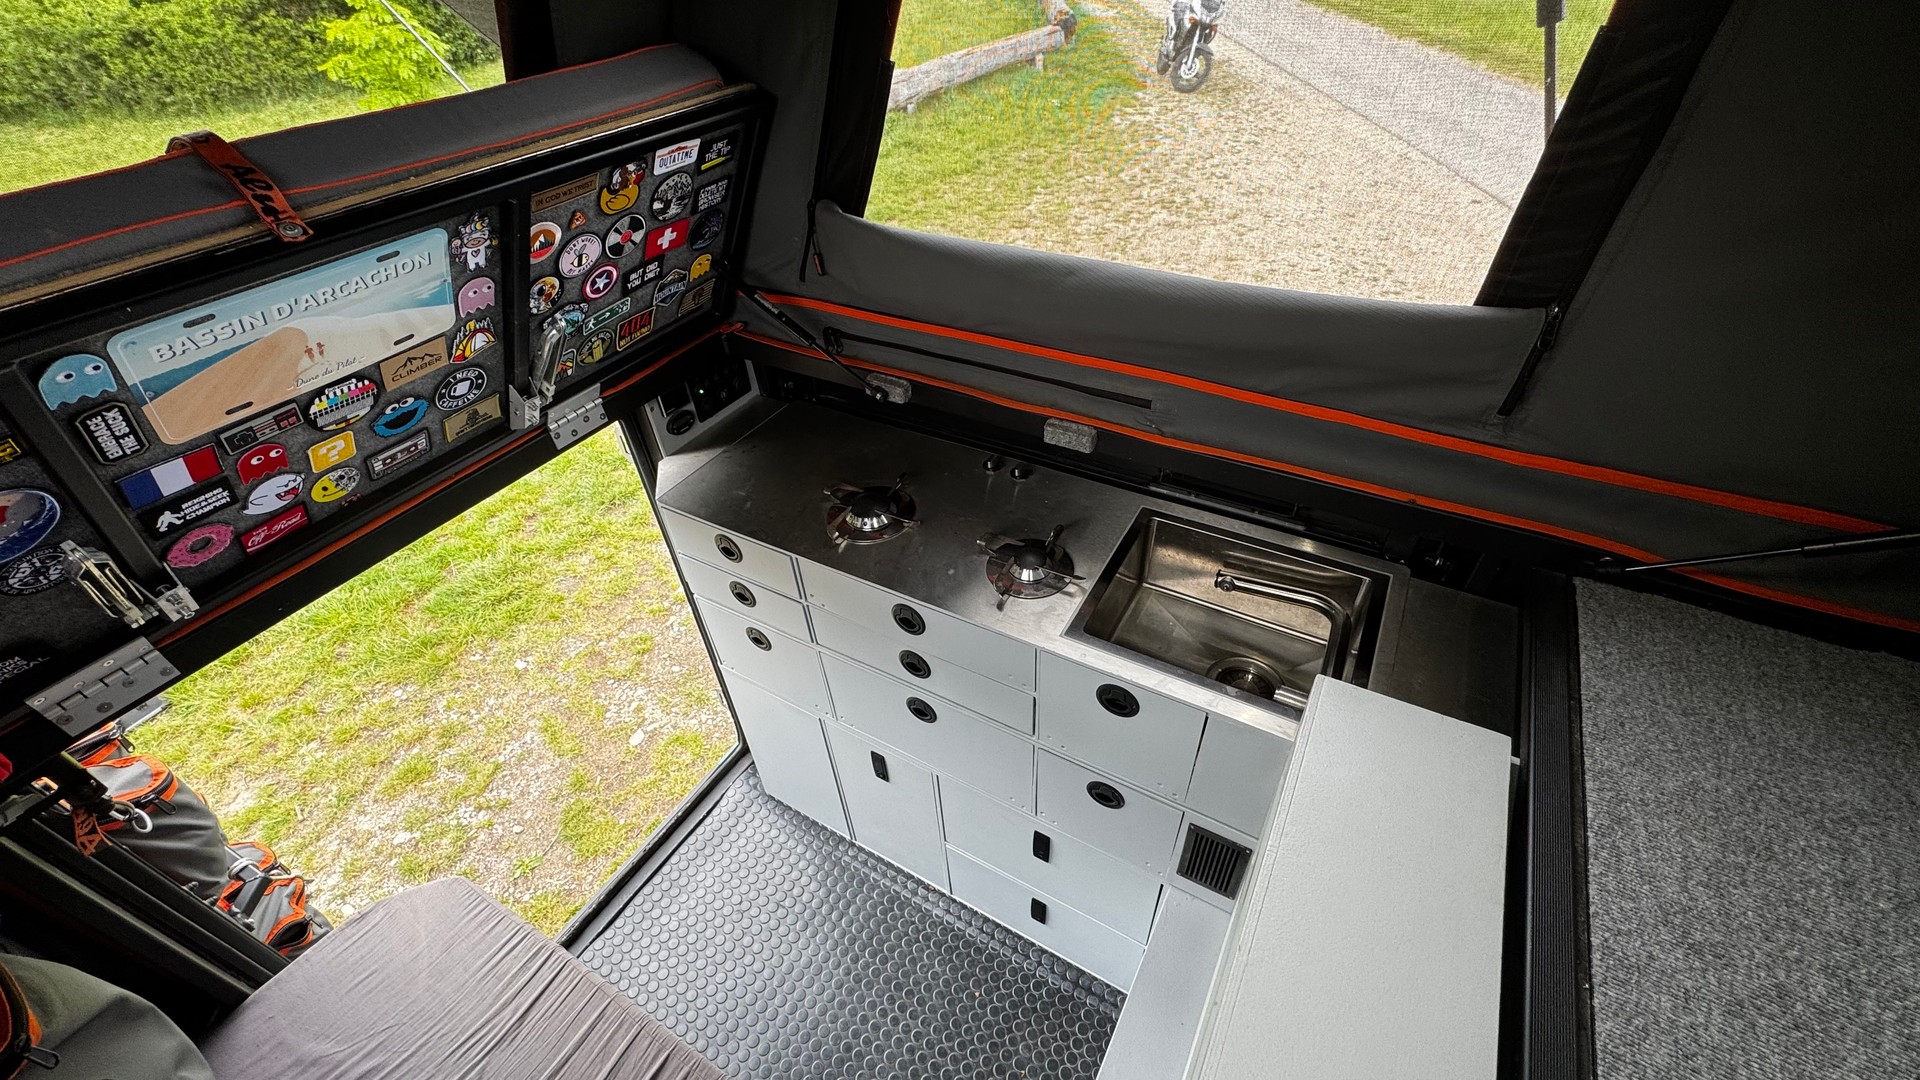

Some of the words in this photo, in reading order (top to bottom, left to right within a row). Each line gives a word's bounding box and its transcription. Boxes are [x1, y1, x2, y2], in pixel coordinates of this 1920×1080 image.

[705, 151, 718, 162] THE
[720, 145, 731, 156] TIP
[710, 139, 728, 152] JUST
[658, 148, 694, 168] OUTATIME
[627, 276, 642, 290] YOU
[644, 268, 660, 281] DIE?
[629, 268, 644, 281] BUT
[646, 261, 659, 273] DID
[150, 310, 268, 363] BASSIN
[269, 251, 432, 320] D'ARCACHON
[620, 311, 650, 337] 404
[294, 375, 321, 389] Dune
[322, 367, 335, 378] du
[391, 355, 442, 382] CLIMBER
[456, 370, 479, 379] NEED
[439, 389, 479, 408] CAFFEINE
[101, 407, 130, 436] SUCK
[87, 415, 123, 460] EMBRACE
[118, 434, 141, 455] THE
[181, 487, 224, 510] REIGNING
[186, 496, 231, 520] CHAMPION
